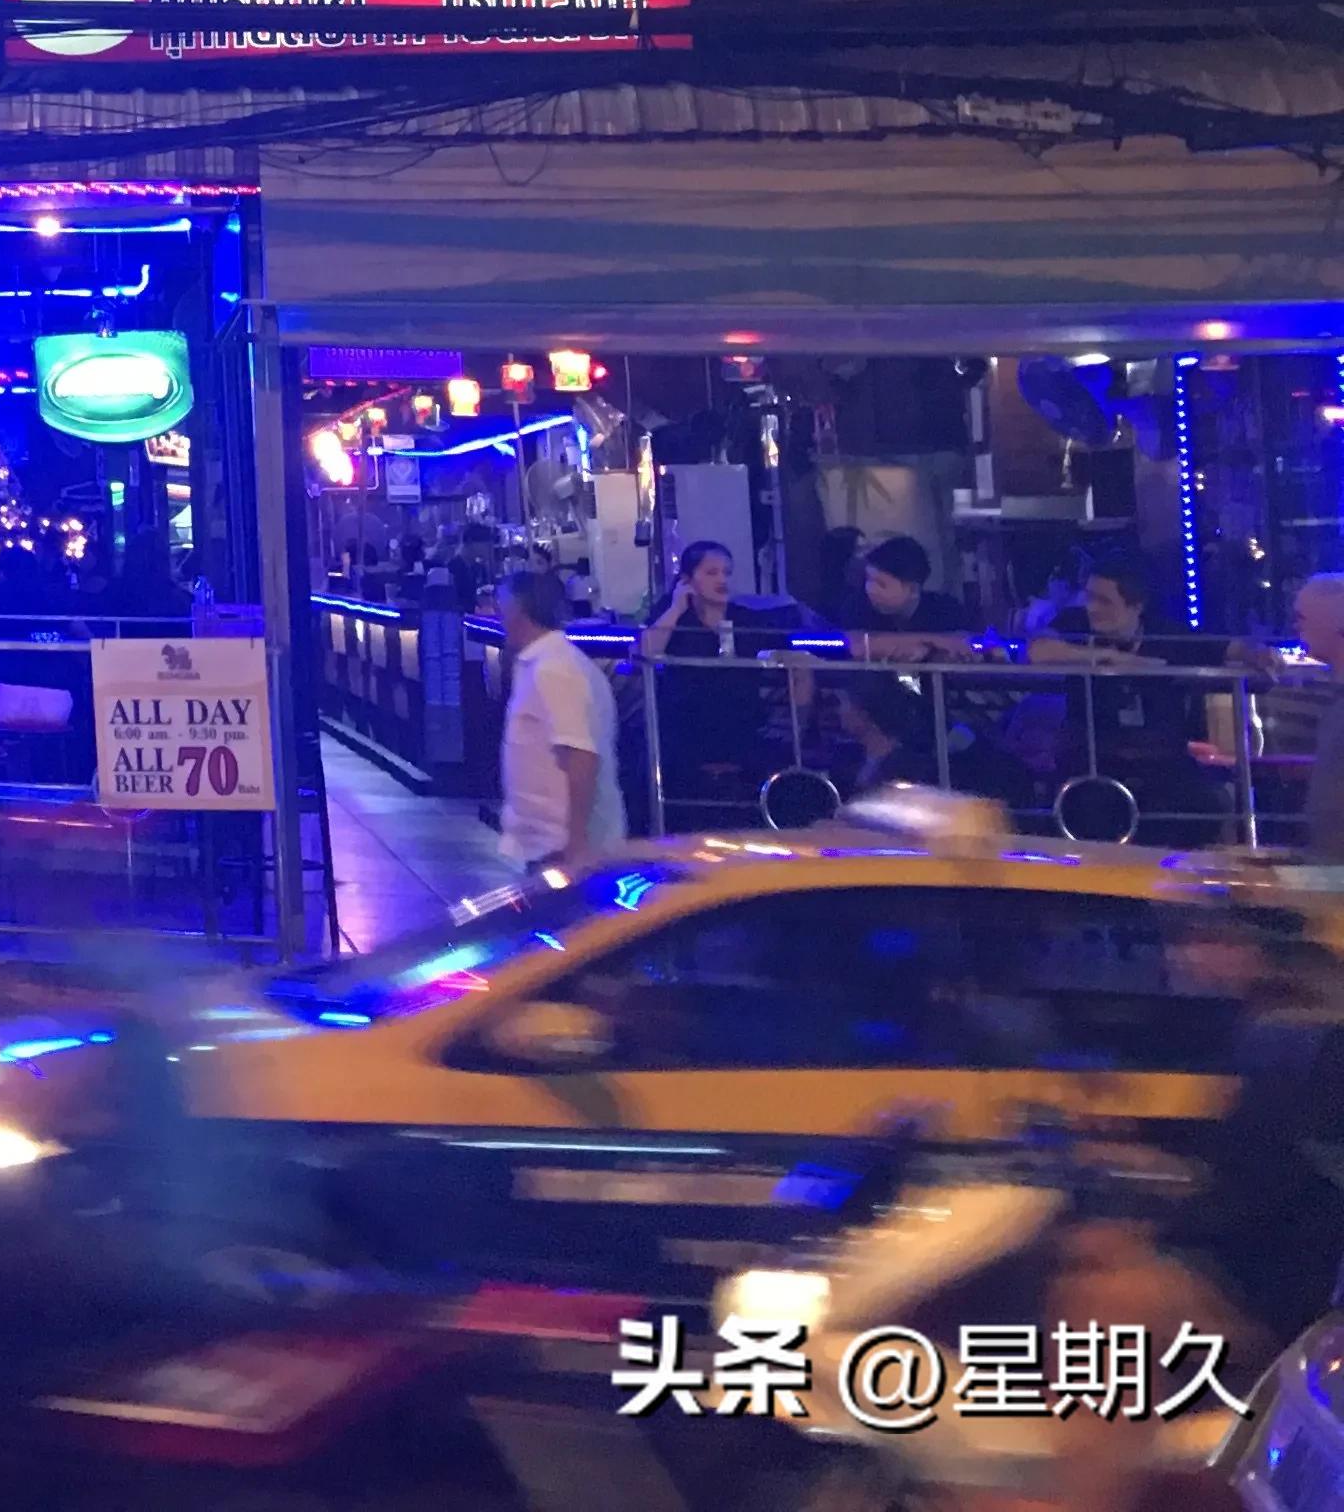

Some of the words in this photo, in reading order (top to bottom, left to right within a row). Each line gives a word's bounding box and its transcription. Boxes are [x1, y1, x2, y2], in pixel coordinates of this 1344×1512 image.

[109, 698, 173, 726] ALL
[185, 698, 252, 726] DAY
[113, 728, 142, 741] 6:00
[112, 747, 174, 773] ALL
[177, 745, 239, 797] 70
[114, 773, 175, 794] BEER
